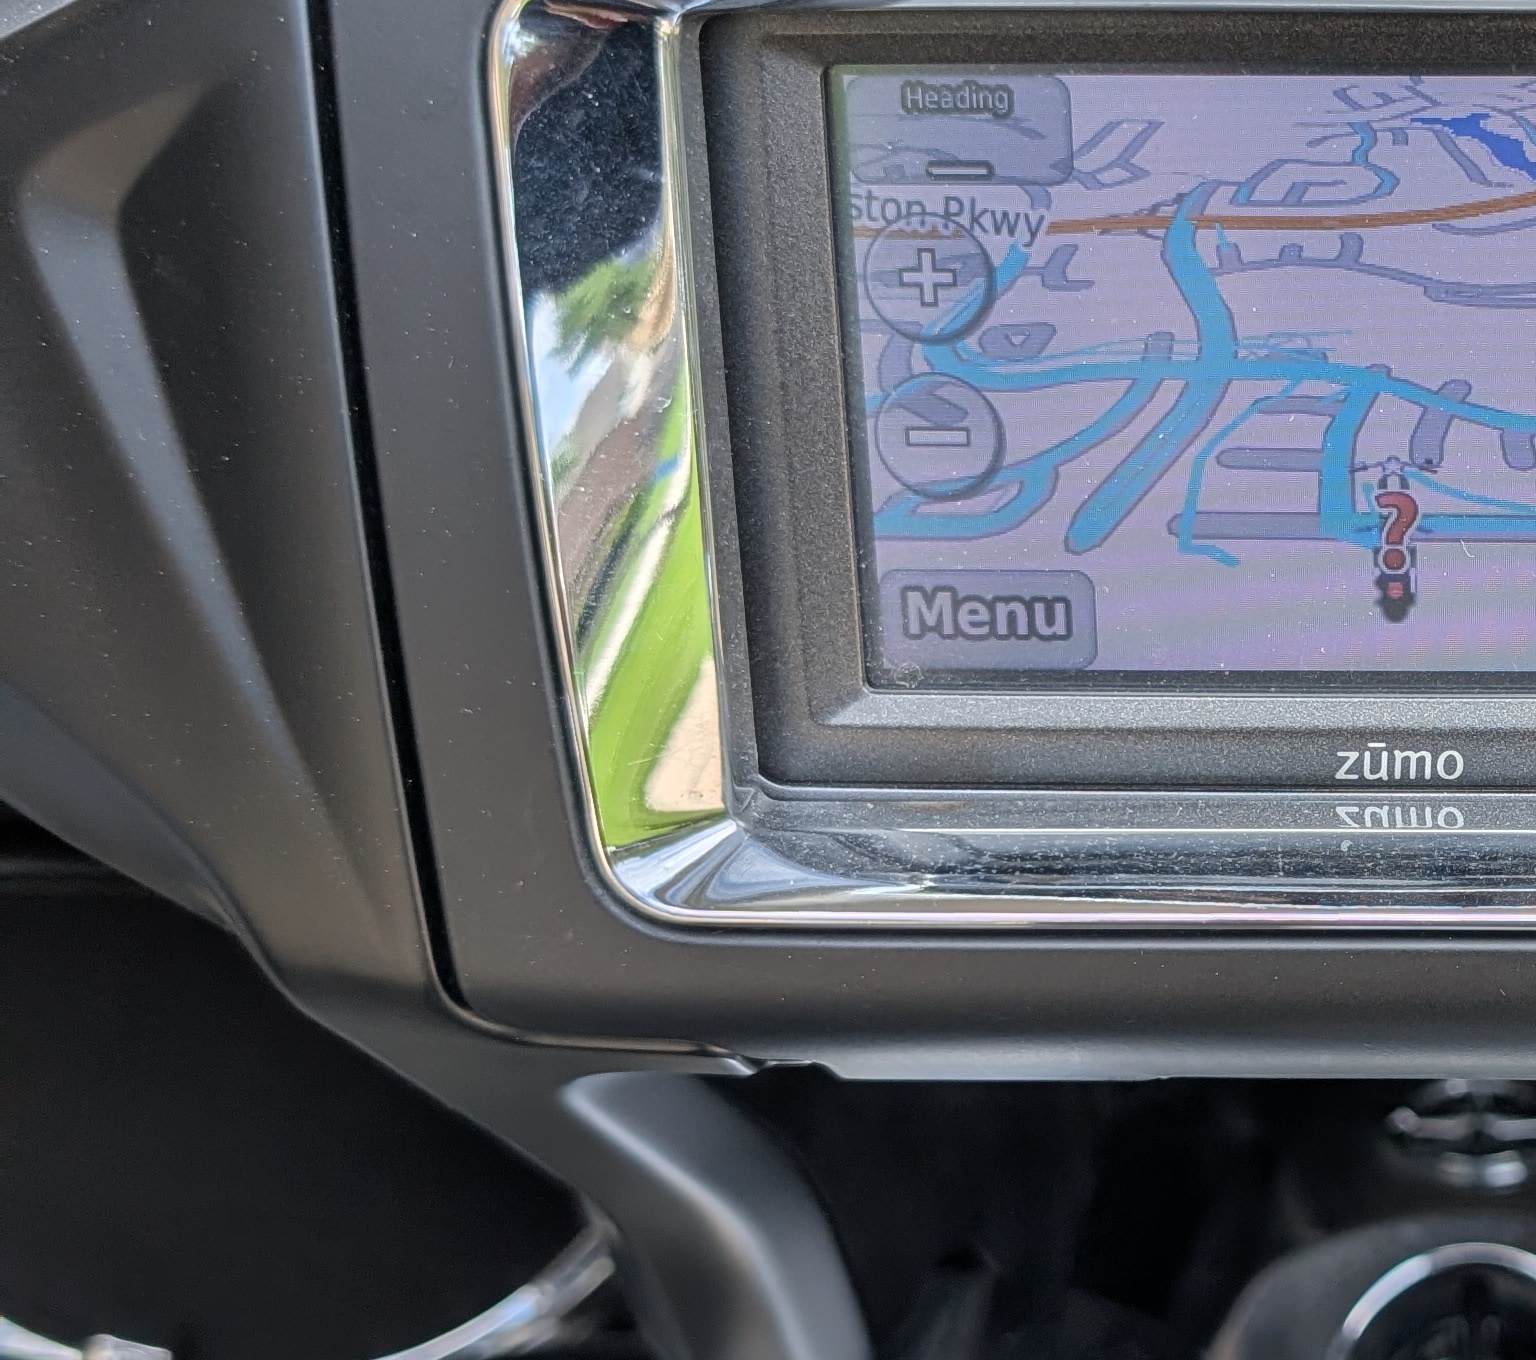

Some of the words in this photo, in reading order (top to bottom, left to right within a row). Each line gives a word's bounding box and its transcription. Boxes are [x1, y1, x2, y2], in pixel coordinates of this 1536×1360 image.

[904, 83, 1011, 116] Heading
[943, 195, 1046, 248] Pkwy
[905, 589, 1069, 637] Menu
